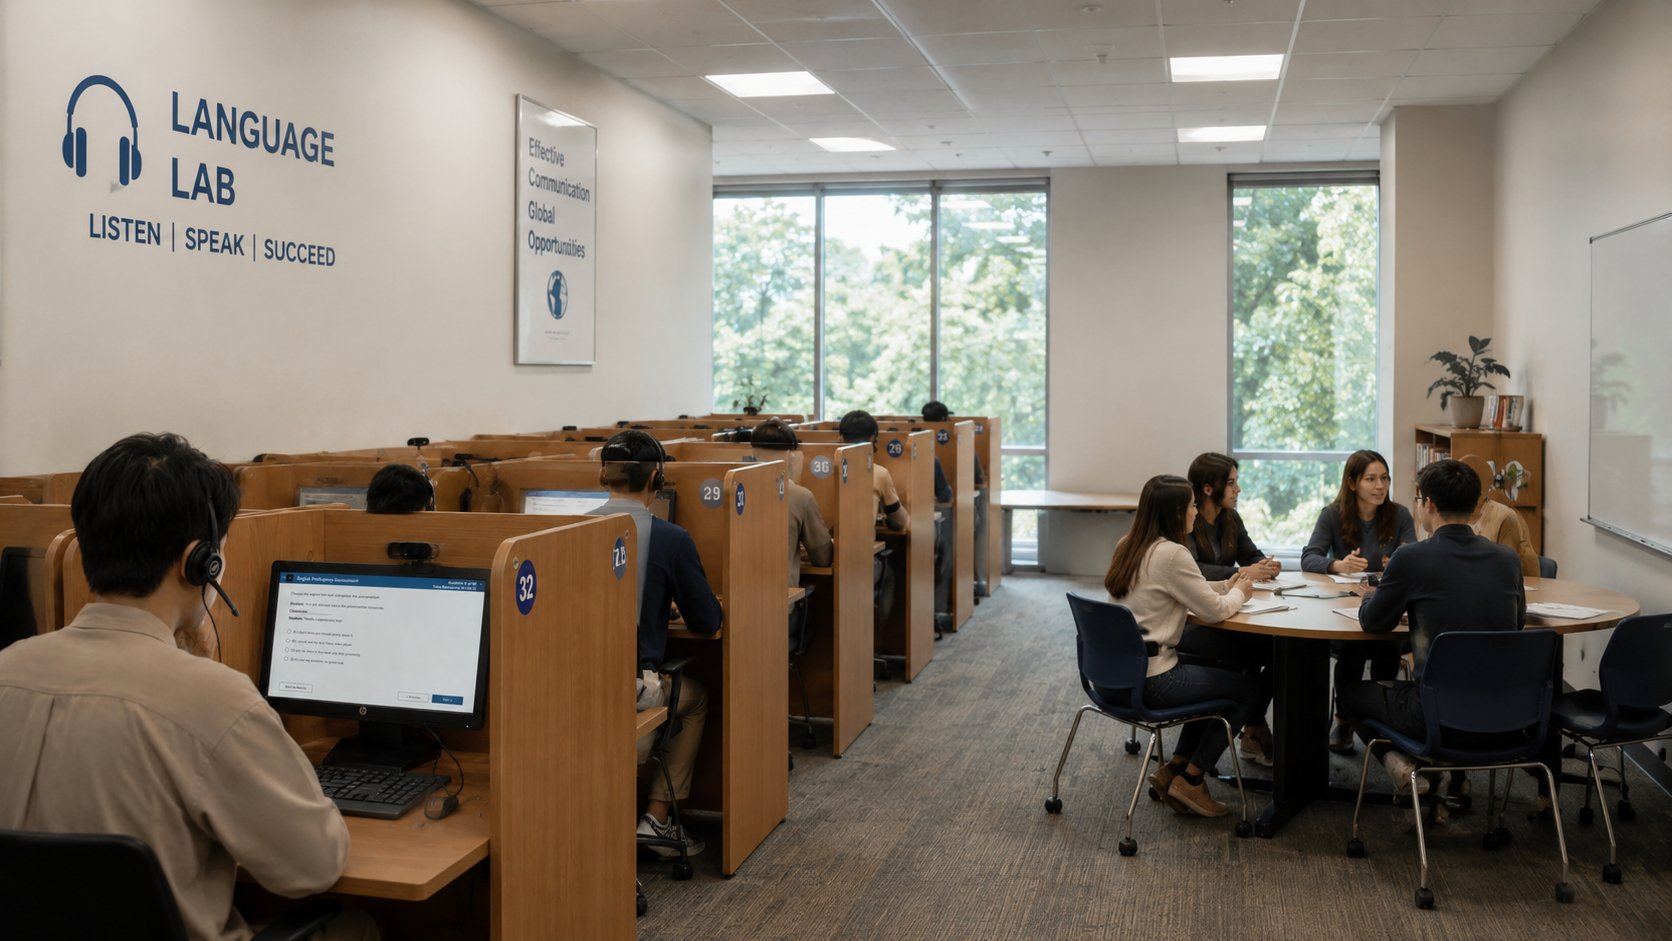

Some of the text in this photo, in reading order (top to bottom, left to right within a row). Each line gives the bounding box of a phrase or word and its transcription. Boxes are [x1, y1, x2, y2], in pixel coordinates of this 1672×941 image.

[172, 90, 335, 167] LANGUAGE
[529, 137, 565, 167] Effective
[171, 156, 236, 206] LAB
[528, 166, 590, 203] Communication
[528, 200, 555, 225] Global
[89, 212, 336, 267] LISTEN SPEAK SUCCEED
[813, 460, 830, 473] 36
[703, 485, 721, 501] 29
[519, 573, 534, 602] 32
